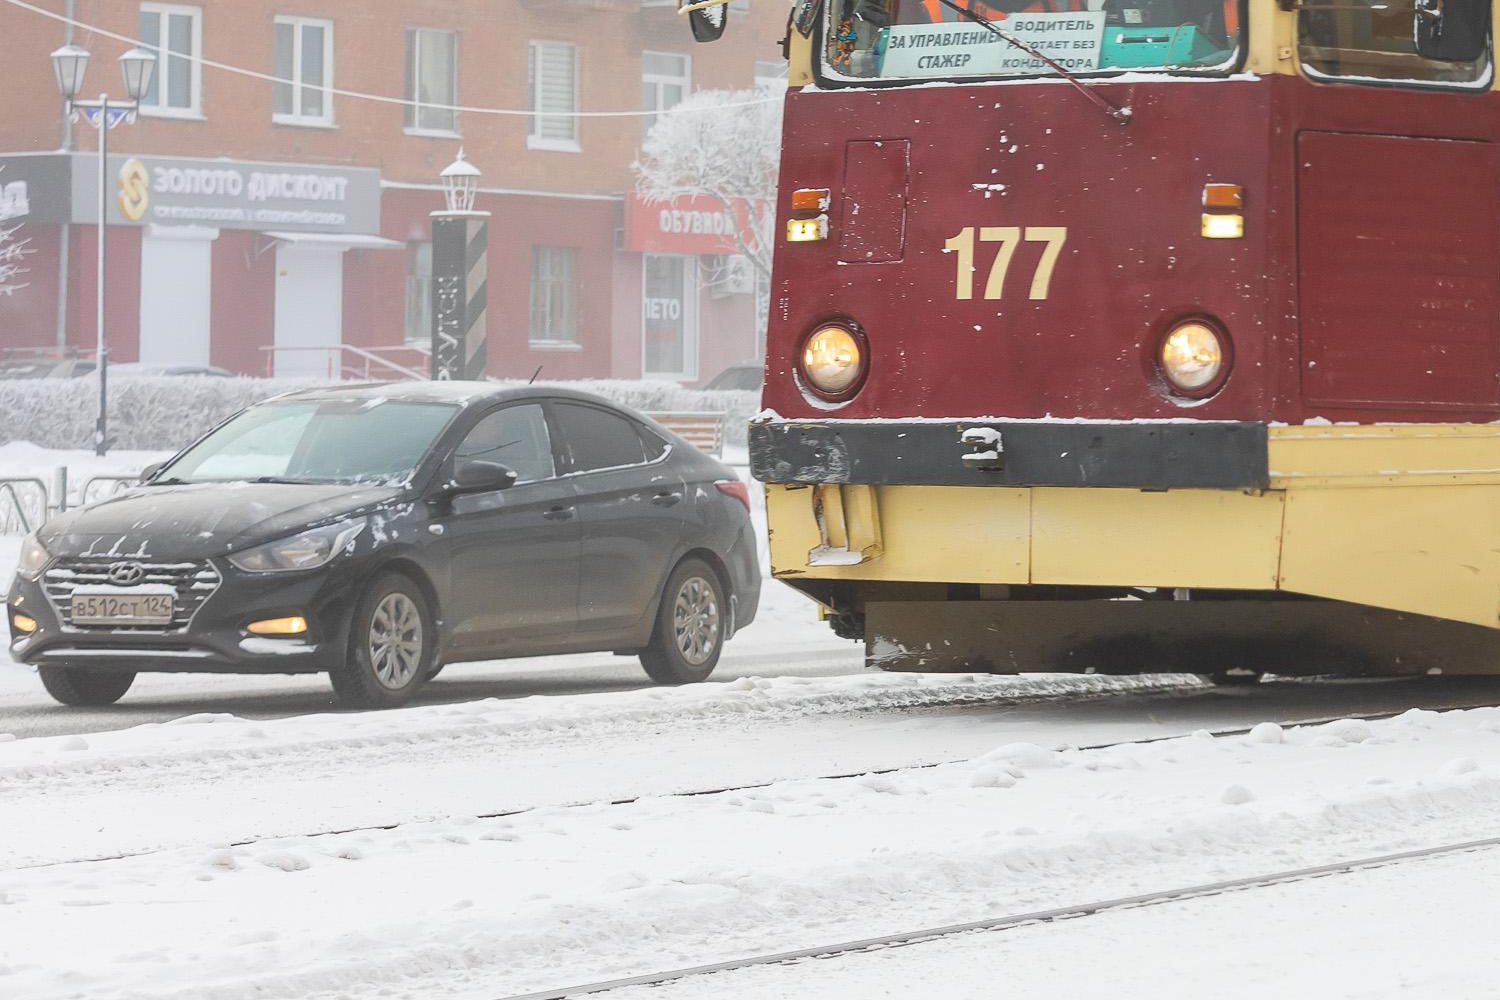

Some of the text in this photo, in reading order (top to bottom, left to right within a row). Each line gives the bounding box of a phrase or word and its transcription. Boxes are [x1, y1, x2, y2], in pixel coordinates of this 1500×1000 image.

[1014, 20, 1095, 33] ВОДИТЕЛЬ
[889, 35, 905, 49] ЗА
[1006, 40, 1096, 50] РОТАЕТ БЕЗ
[917, 54, 971, 69] СТАЖЕР
[153, 166, 348, 201] ЗОЛОТО ДИСКОНТ
[944, 226, 1068, 300] 177
[77, 598, 139, 617] В512СТ
